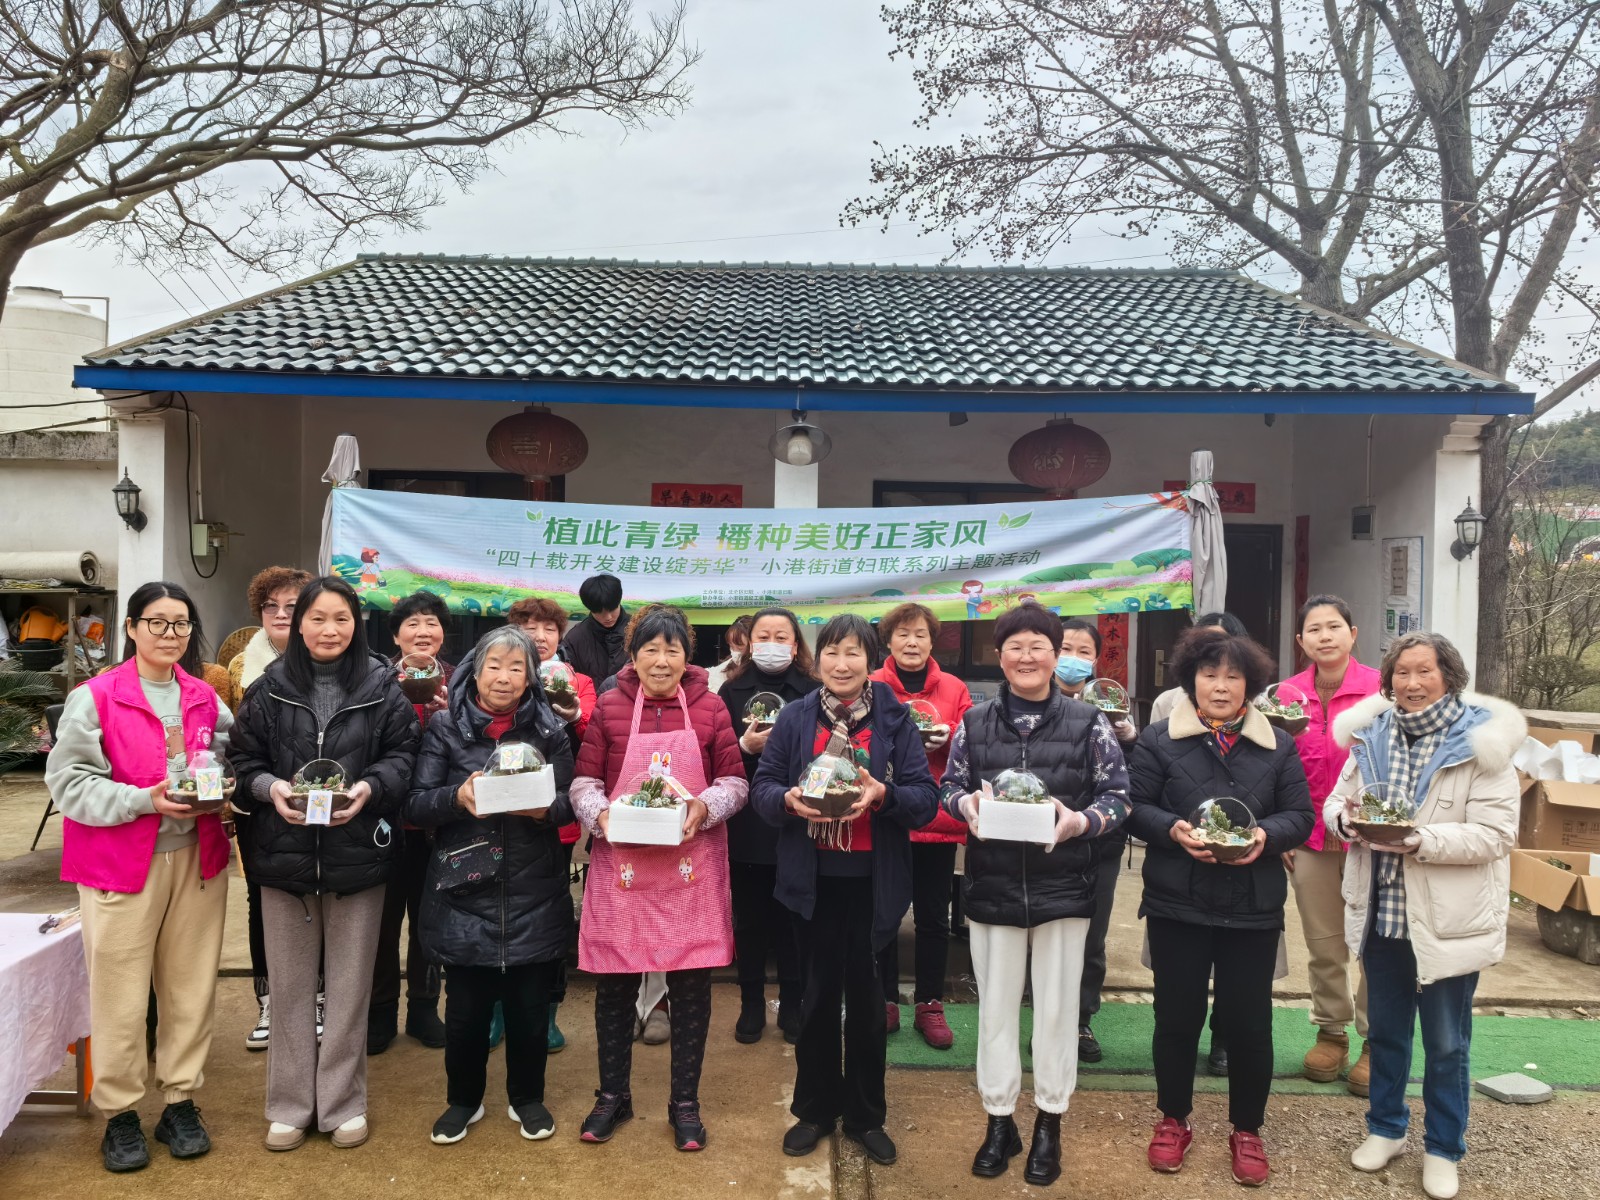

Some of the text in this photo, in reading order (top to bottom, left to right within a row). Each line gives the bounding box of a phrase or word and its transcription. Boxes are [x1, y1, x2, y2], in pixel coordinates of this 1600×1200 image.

[543, 516, 988, 552] 植此青绿 播种美好正家风
[486, 548, 1041, 576] “四十载开发建设绽芳华” 小港街道妇联系列主题活动
